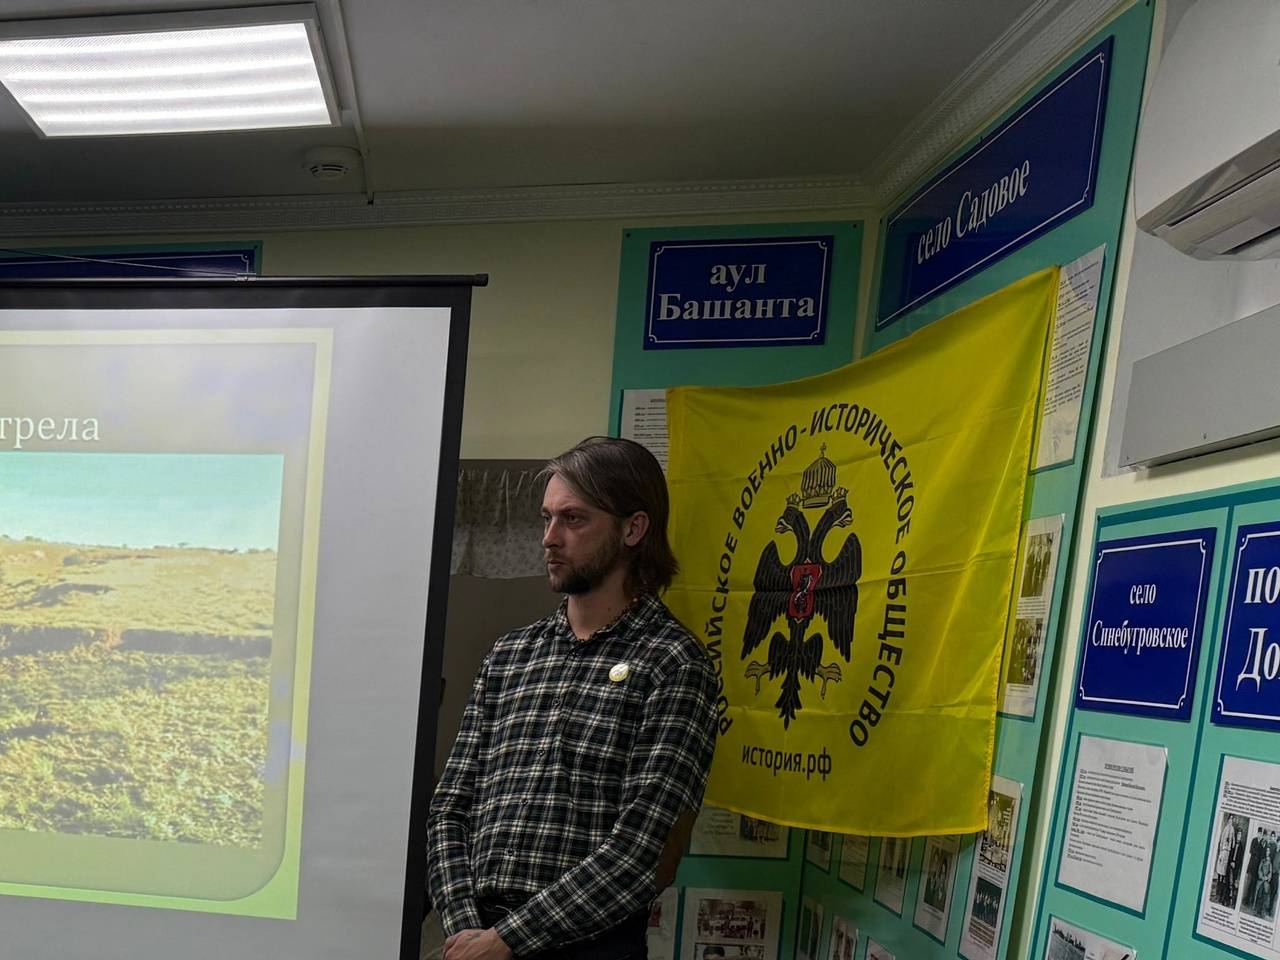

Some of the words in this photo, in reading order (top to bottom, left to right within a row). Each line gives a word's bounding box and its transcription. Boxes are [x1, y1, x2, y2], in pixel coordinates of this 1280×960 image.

[917, 216, 952, 265] село
[956, 160, 1030, 238] Садовое
[709, 263, 767, 293] аул
[657, 293, 816, 321] Башанта
[1129, 583, 1157, 606] село
[849, 550, 908, 747] ОБЩЕСТВО
[1092, 619, 1189, 655] Синебугровское
[1235, 627, 1280, 693] До
[741, 744, 833, 782] история.рф
